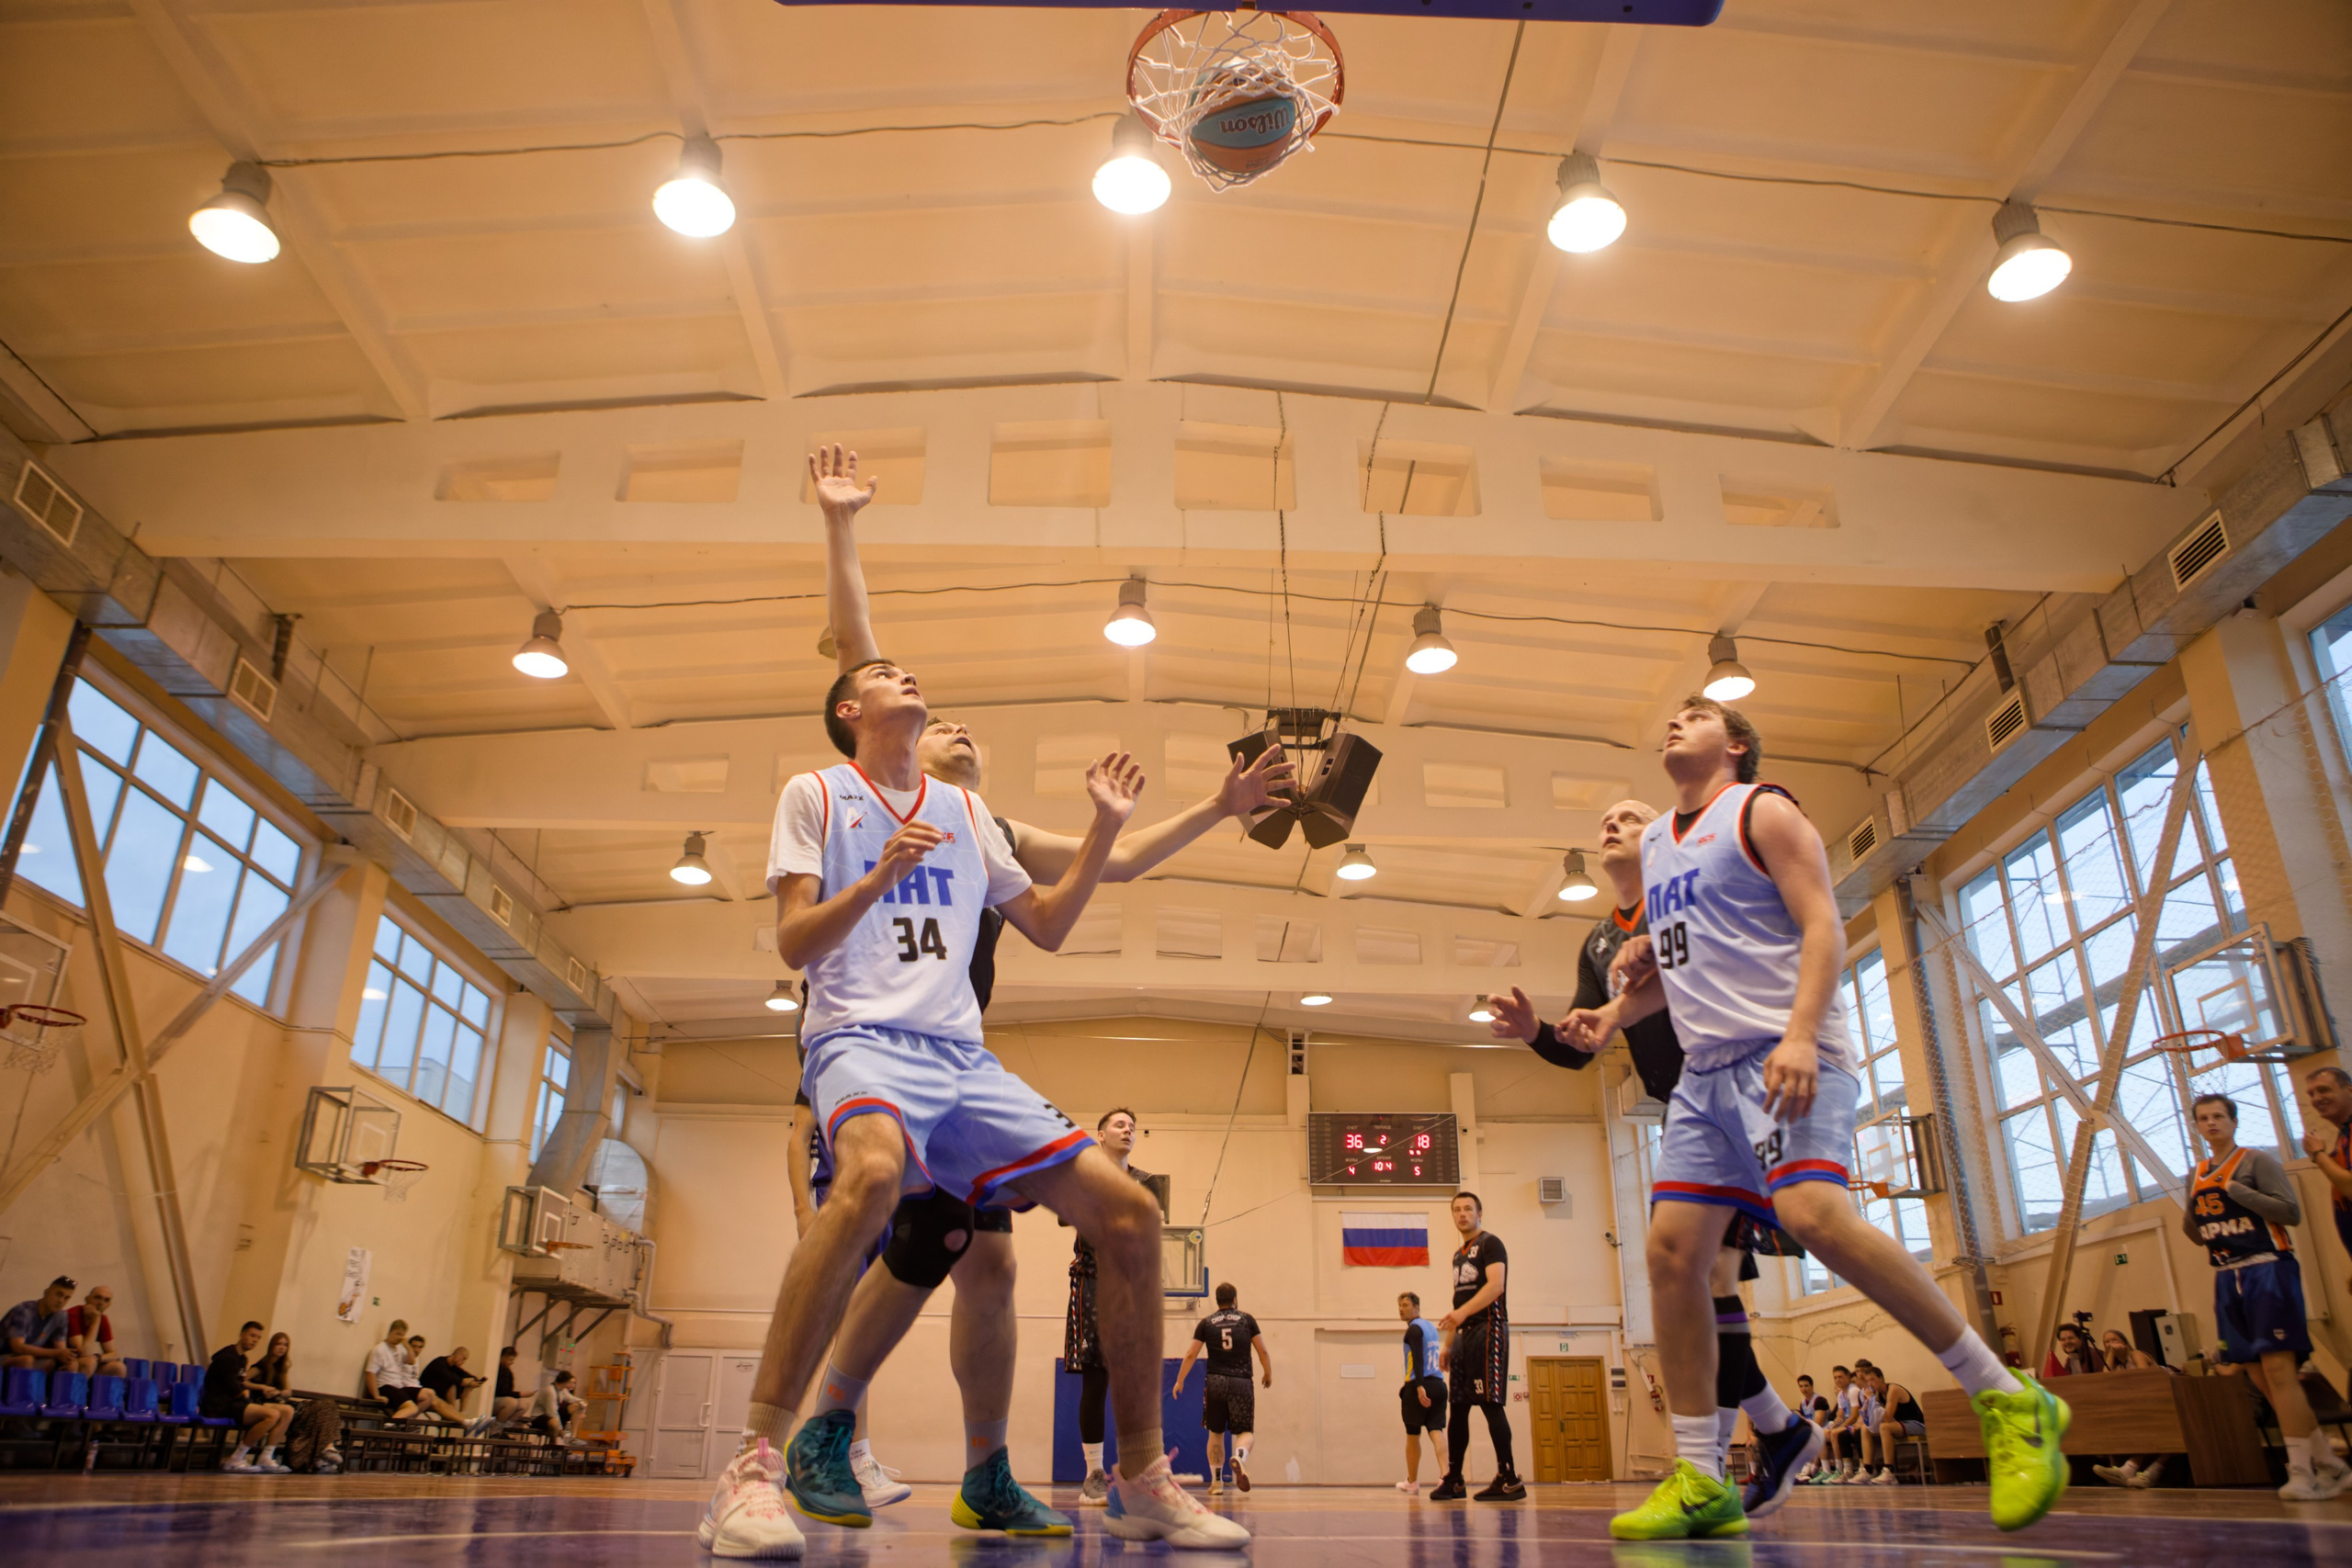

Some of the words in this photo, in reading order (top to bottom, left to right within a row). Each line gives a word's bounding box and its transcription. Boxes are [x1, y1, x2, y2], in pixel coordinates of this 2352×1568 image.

[1219, 106, 1290, 134] Wilson
[1648, 867, 1701, 923] ПАТ
[892, 917, 948, 963] 34
[1659, 921, 1689, 969] 99
[1346, 1134, 1363, 1149] 36
[1379, 1134, 1387, 1145] 2
[1417, 1134, 1430, 1148] 18
[1348, 1166, 1356, 1175] 4
[1414, 1166, 1421, 1176] 5
[2195, 1193, 2224, 1216] 45
[1221, 1327, 1233, 1350] 5
[1474, 1379, 1484, 1394] 33
